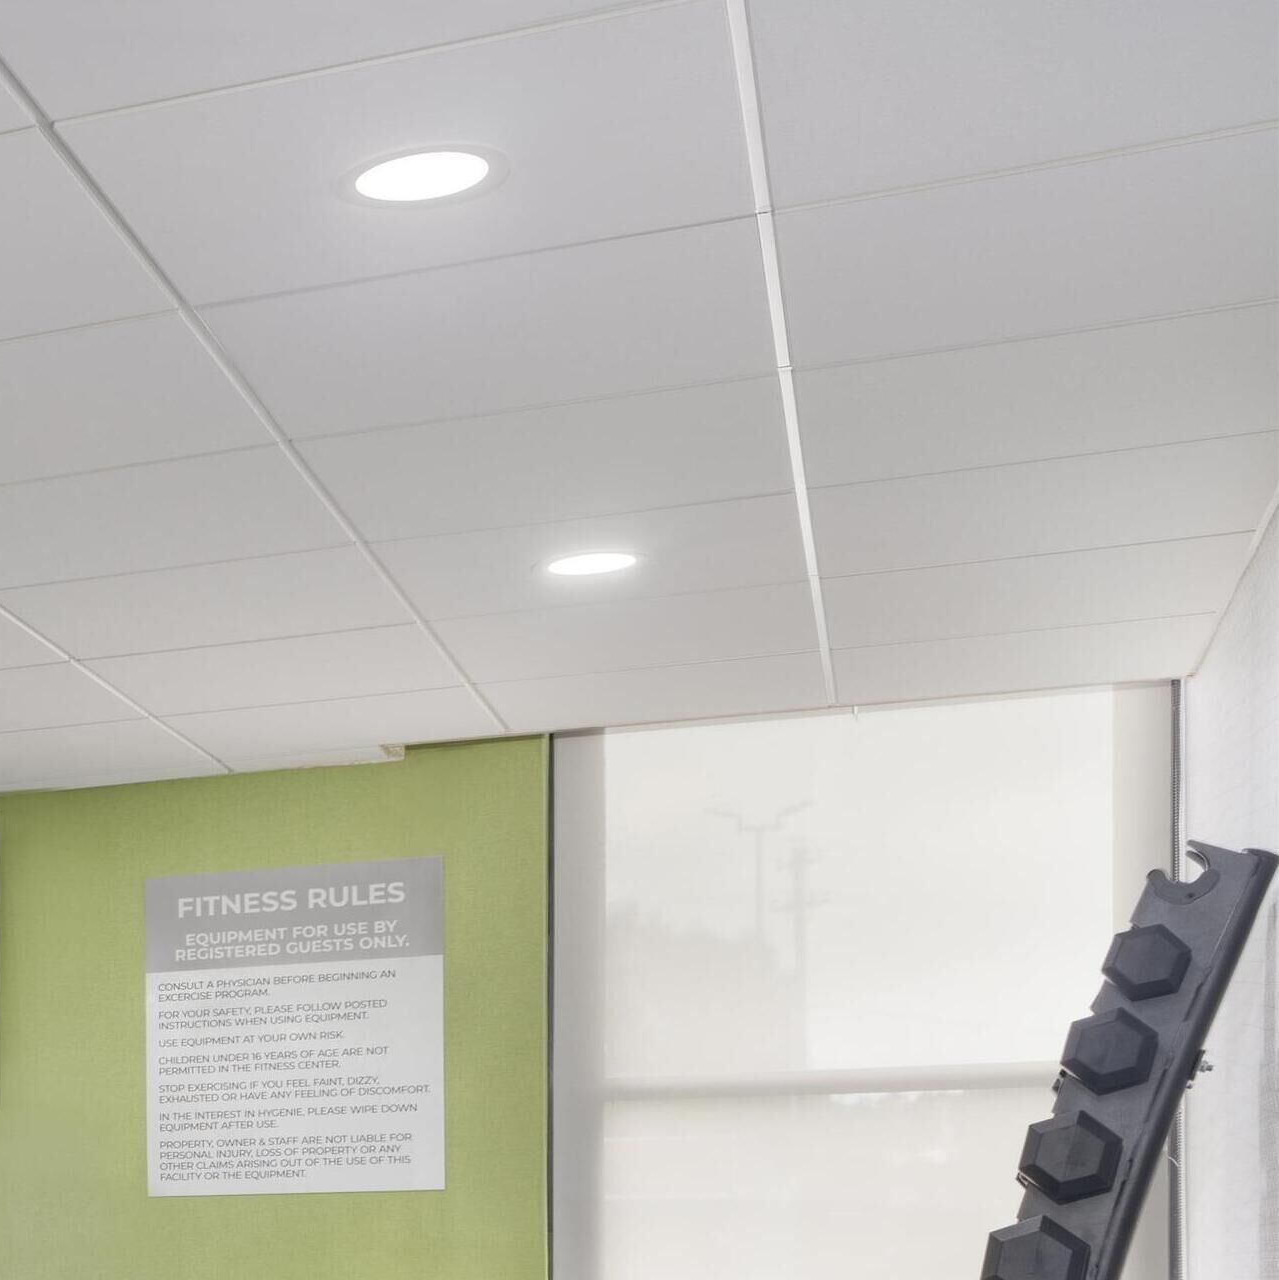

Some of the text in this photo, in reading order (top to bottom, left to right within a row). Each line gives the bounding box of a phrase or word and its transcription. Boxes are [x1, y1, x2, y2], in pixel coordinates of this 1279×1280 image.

[177, 881, 404, 918] FITNESS RULES
[185, 920, 397, 946] EQUIPMENT FOR USE BY
[175, 934, 409, 961] REGISTERED GUESTS ONLY.
[158, 981, 203, 991] CONSULT
[216, 977, 271, 987] PHYSICIAN
[273, 975, 314, 984] BEFORE
[318, 971, 377, 982] BEGINNING
[380, 970, 396, 978] AN
[158, 1011, 180, 1019] FOR
[182, 1009, 210, 1018] YOUR
[254, 1004, 293, 1014] PLEASE
[296, 1002, 342, 1012] FOLLOW
[344, 999, 388, 1009] POSTED
[159, 1019, 232, 1030] INSTRUCTIONS
[235, 1017, 267, 1026] WHEN
[270, 1015, 302, 1024] USING
[159, 1039, 178, 1047] USE
[181, 1036, 240, 1047] EQUIPMENT
[243, 1035, 254, 1043] AT
[258, 1033, 287, 1042] YOUR
[289, 1032, 317, 1041] OWN
[159, 1046, 389, 1064] CHILDREN UNDER 16 YEARS OF AGE ARE NOT
[159, 1065, 216, 1075] PERMITTED
[233, 1064, 250, 1072] THE
[254, 1061, 295, 1071] FITNESS
[159, 1084, 185, 1092] STOP
[187, 1081, 247, 1091] EXERCISING
[249, 1081, 258, 1089] IF
[262, 1080, 283, 1088] YOU
[286, 1079, 308, 1087] FEEL
[159, 1094, 219, 1103] EXHAUSTED
[221, 1093, 237, 1101] OR
[240, 1092, 267, 1100] HAVE
[270, 1091, 291, 1099] ANY
[294, 1089, 338, 1098] FEELING
[340, 1088, 353, 1096] OF
[159, 1113, 170, 1121] IN
[173, 1112, 191, 1120] THE
[194, 1110, 241, 1119] INTEREST
[307, 1106, 347, 1115] PLEASE
[350, 1105, 377, 1114] WIPE
[381, 1103, 418, 1112] DOWN
[159, 1122, 218, 1132] EQUIPMENT
[221, 1120, 254, 1129] AFTER
[216, 1138, 256, 1147] OWNER
[268, 1137, 298, 1145] STAFF
[301, 1136, 322, 1144] ARE
[325, 1135, 346, 1143] NOT
[350, 1134, 386, 1142] LIABLE
[389, 1133, 412, 1141] FOR
[159, 1150, 211, 1159] PERSONAL
[256, 1148, 282, 1156] LOSS
[302, 1146, 357, 1155] PROPERTY
[360, 1145, 376, 1153] OR
[379, 1144, 401, 1152] ANY
[160, 1162, 194, 1170] OTHER
[196, 1161, 234, 1169] CLAIMS
[236, 1159, 277, 1168] ARISING
[305, 1158, 319, 1166] OF
[323, 1157, 342, 1165] THE
[369, 1156, 383, 1164] OF
[388, 1155, 411, 1163] THIS
[160, 1172, 202, 1180] FACILITY
[223, 1171, 241, 1179] THE
